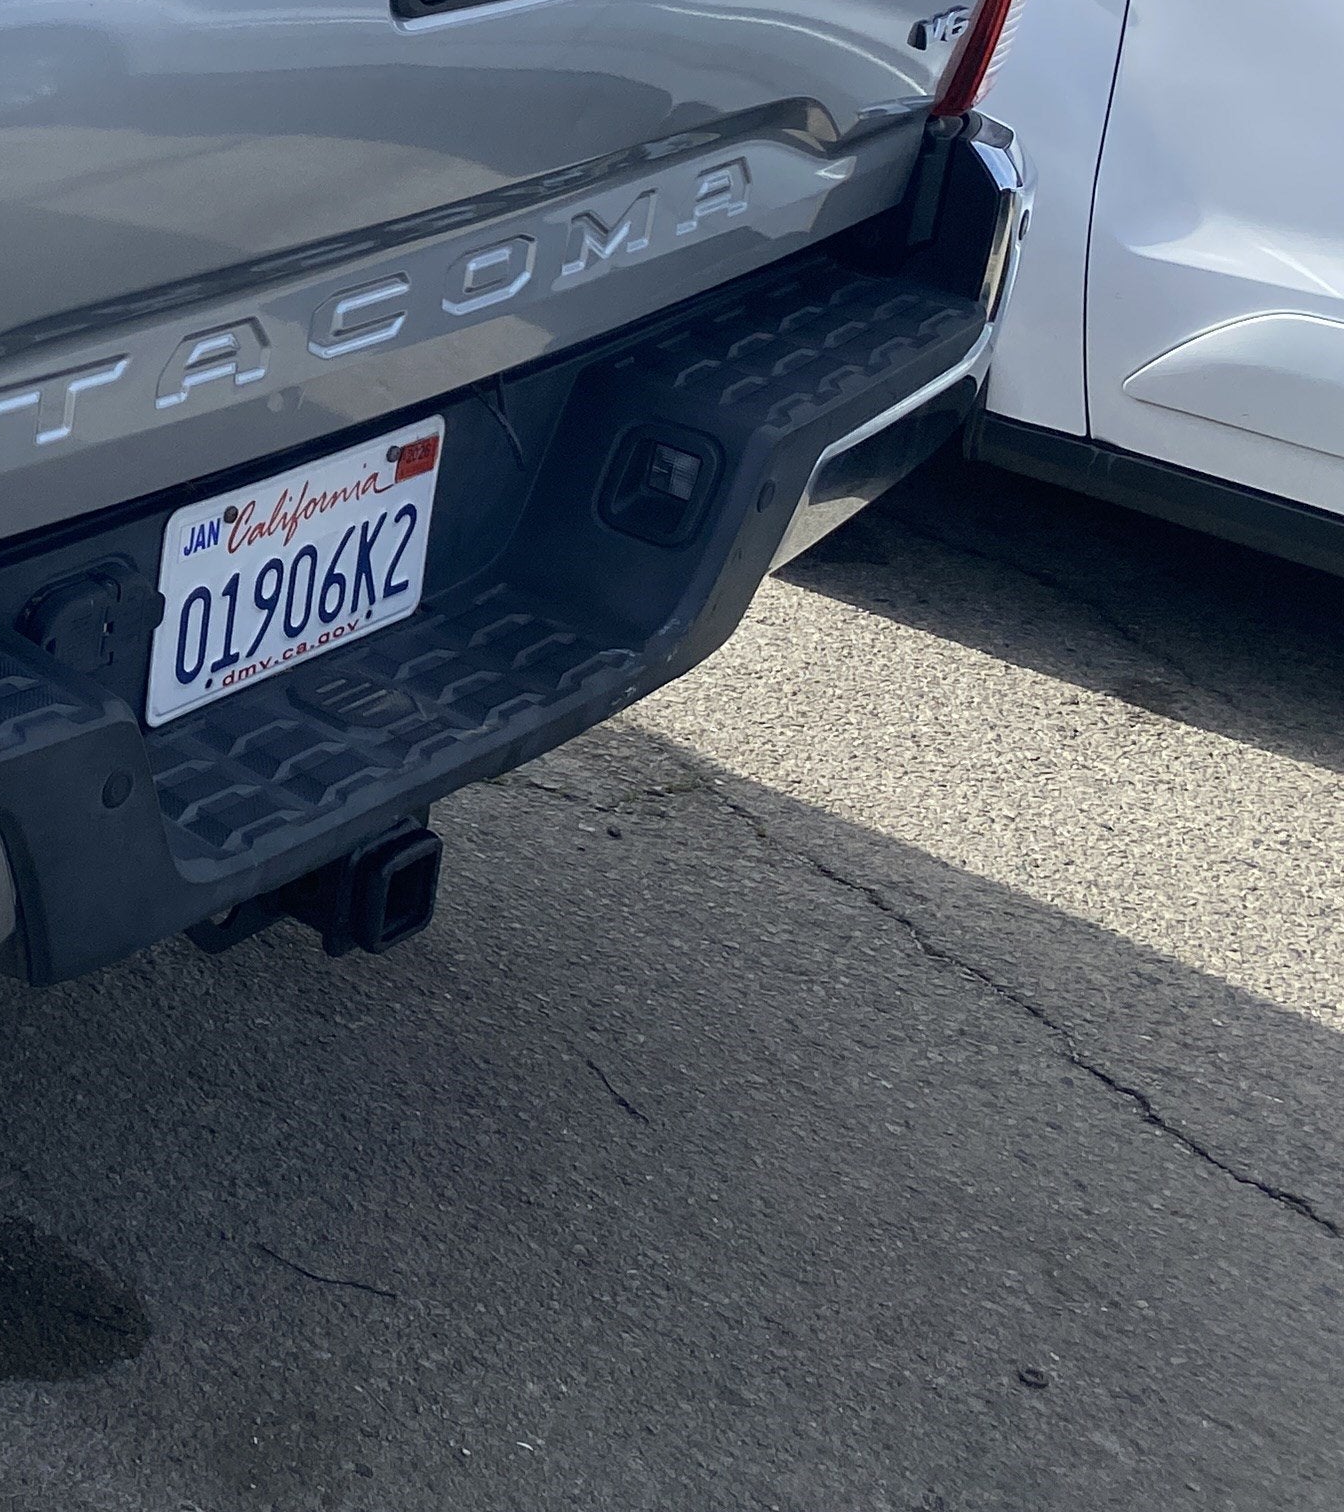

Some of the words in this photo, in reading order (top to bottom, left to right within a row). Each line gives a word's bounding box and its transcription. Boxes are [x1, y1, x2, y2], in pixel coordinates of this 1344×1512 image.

[183, 517, 221, 556] JAN
[228, 463, 395, 554] California
[175, 503, 417, 685] 01906K2
[222, 619, 360, 687] dmv.ca.gov
